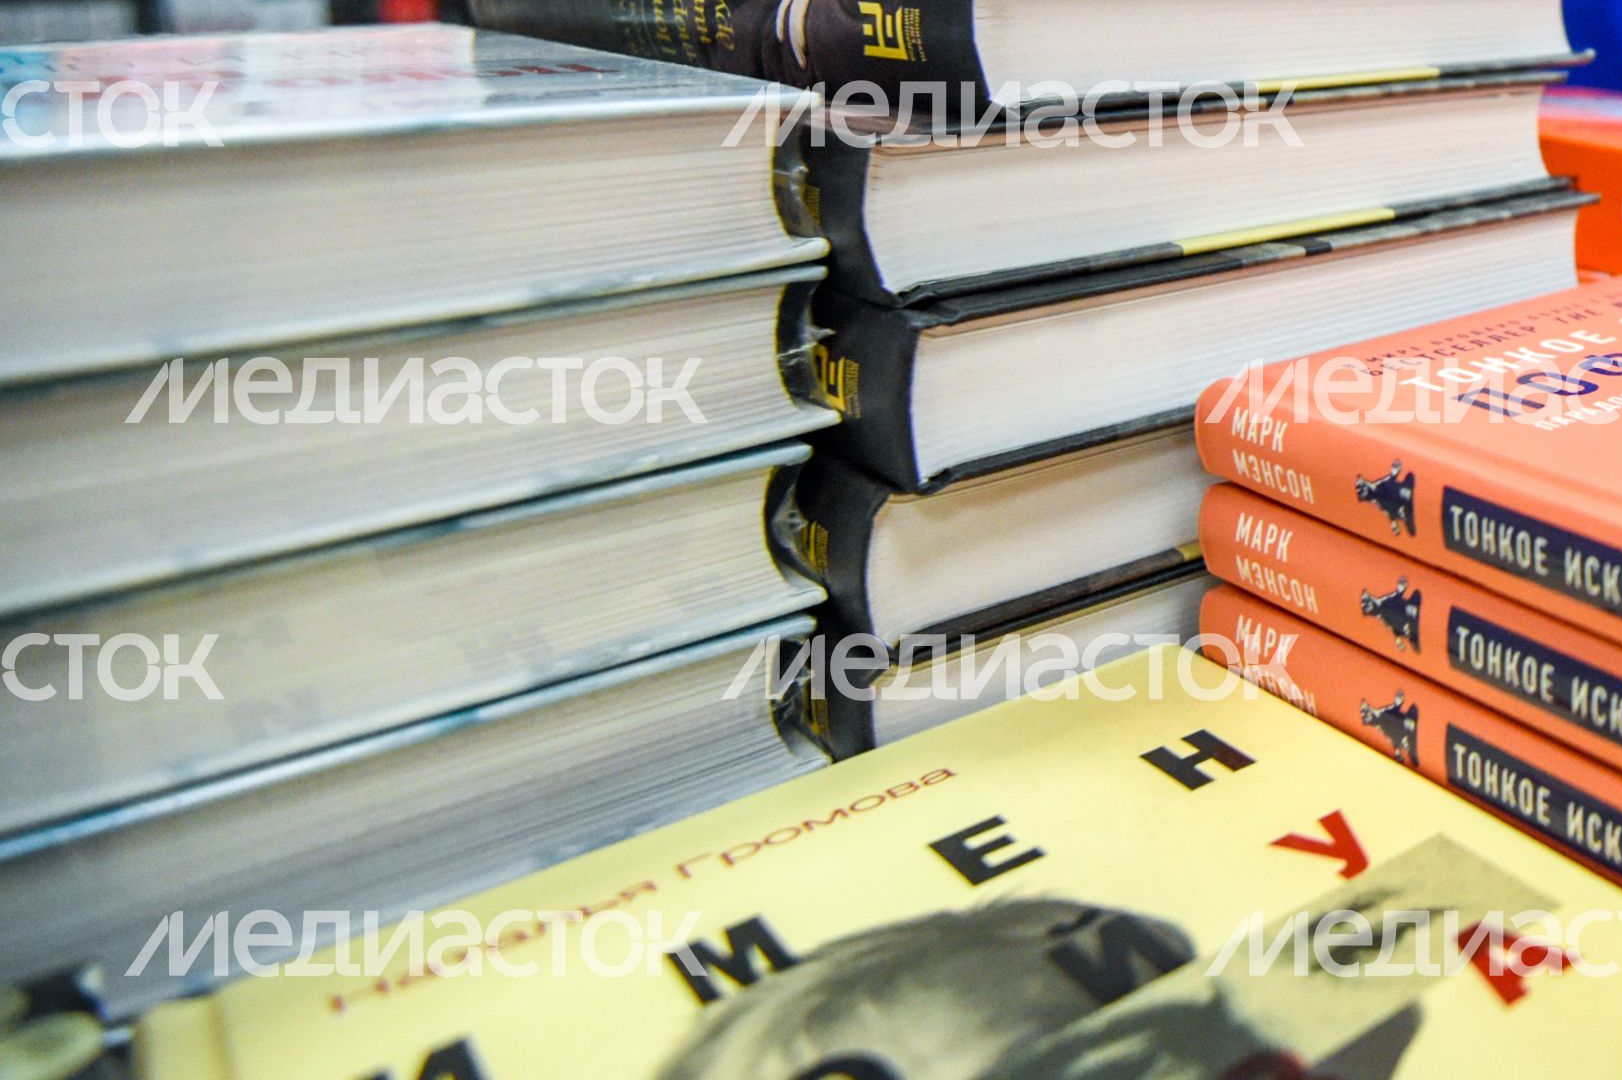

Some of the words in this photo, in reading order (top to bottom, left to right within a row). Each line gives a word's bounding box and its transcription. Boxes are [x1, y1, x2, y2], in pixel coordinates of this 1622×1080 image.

[1400, 330, 1616, 392] ТОНКОЕ
[1231, 406, 1288, 453] МАРК
[1232, 448, 1315, 505] МЭНСОН
[1235, 512, 1293, 562] МАРК
[1449, 504, 1550, 576] ТОНКОЕ
[1236, 554, 1319, 614] МЭНСОН
[1236, 614, 1294, 667] МАРК
[1456, 624, 1555, 703] ТОНКОЕ
[1453, 742, 1552, 827] ТОНКОЕ
[675, 765, 959, 880] Громова
